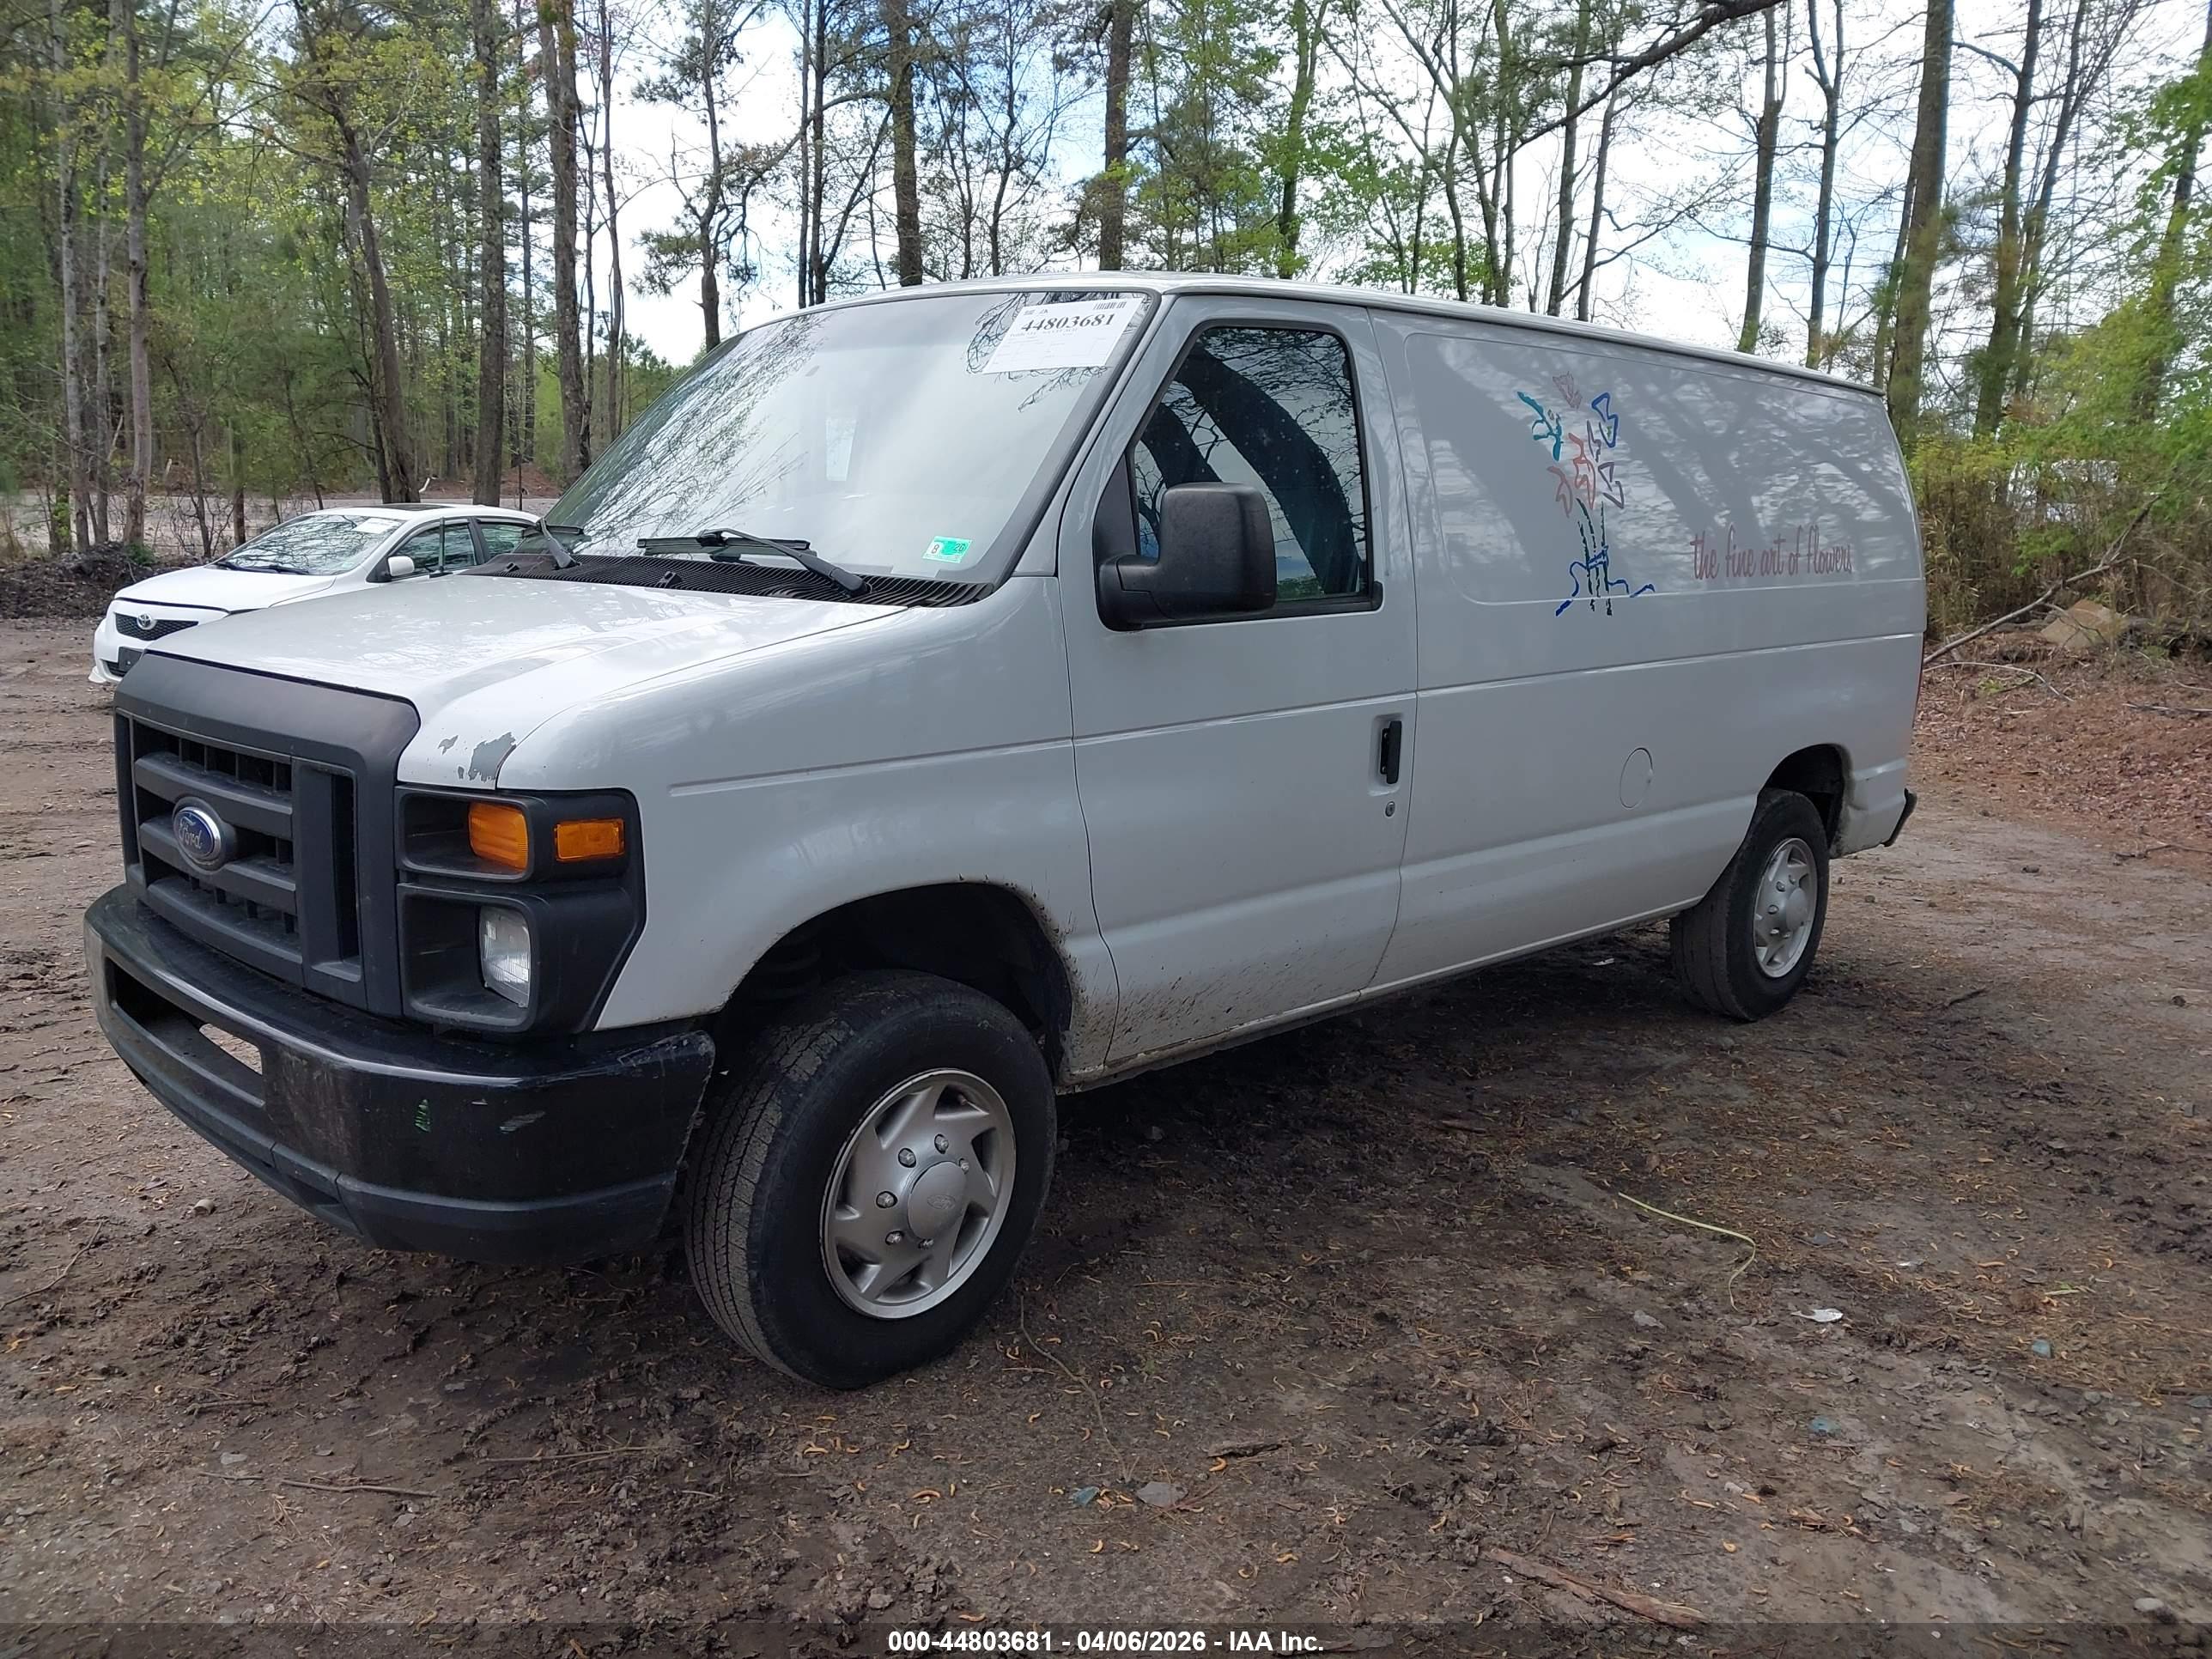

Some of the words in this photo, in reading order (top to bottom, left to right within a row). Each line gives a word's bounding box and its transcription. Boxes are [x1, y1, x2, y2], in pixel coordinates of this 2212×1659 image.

[1022, 313, 1115, 331] 44803681
[931, 544, 940, 554] 8
[1689, 529, 1719, 580] the
[1724, 522, 1757, 578] fine
[1760, 534, 1786, 576] art
[1787, 525, 1802, 576] of
[1807, 524, 1855, 574] flowers
[178, 816, 204, 849] Ford
